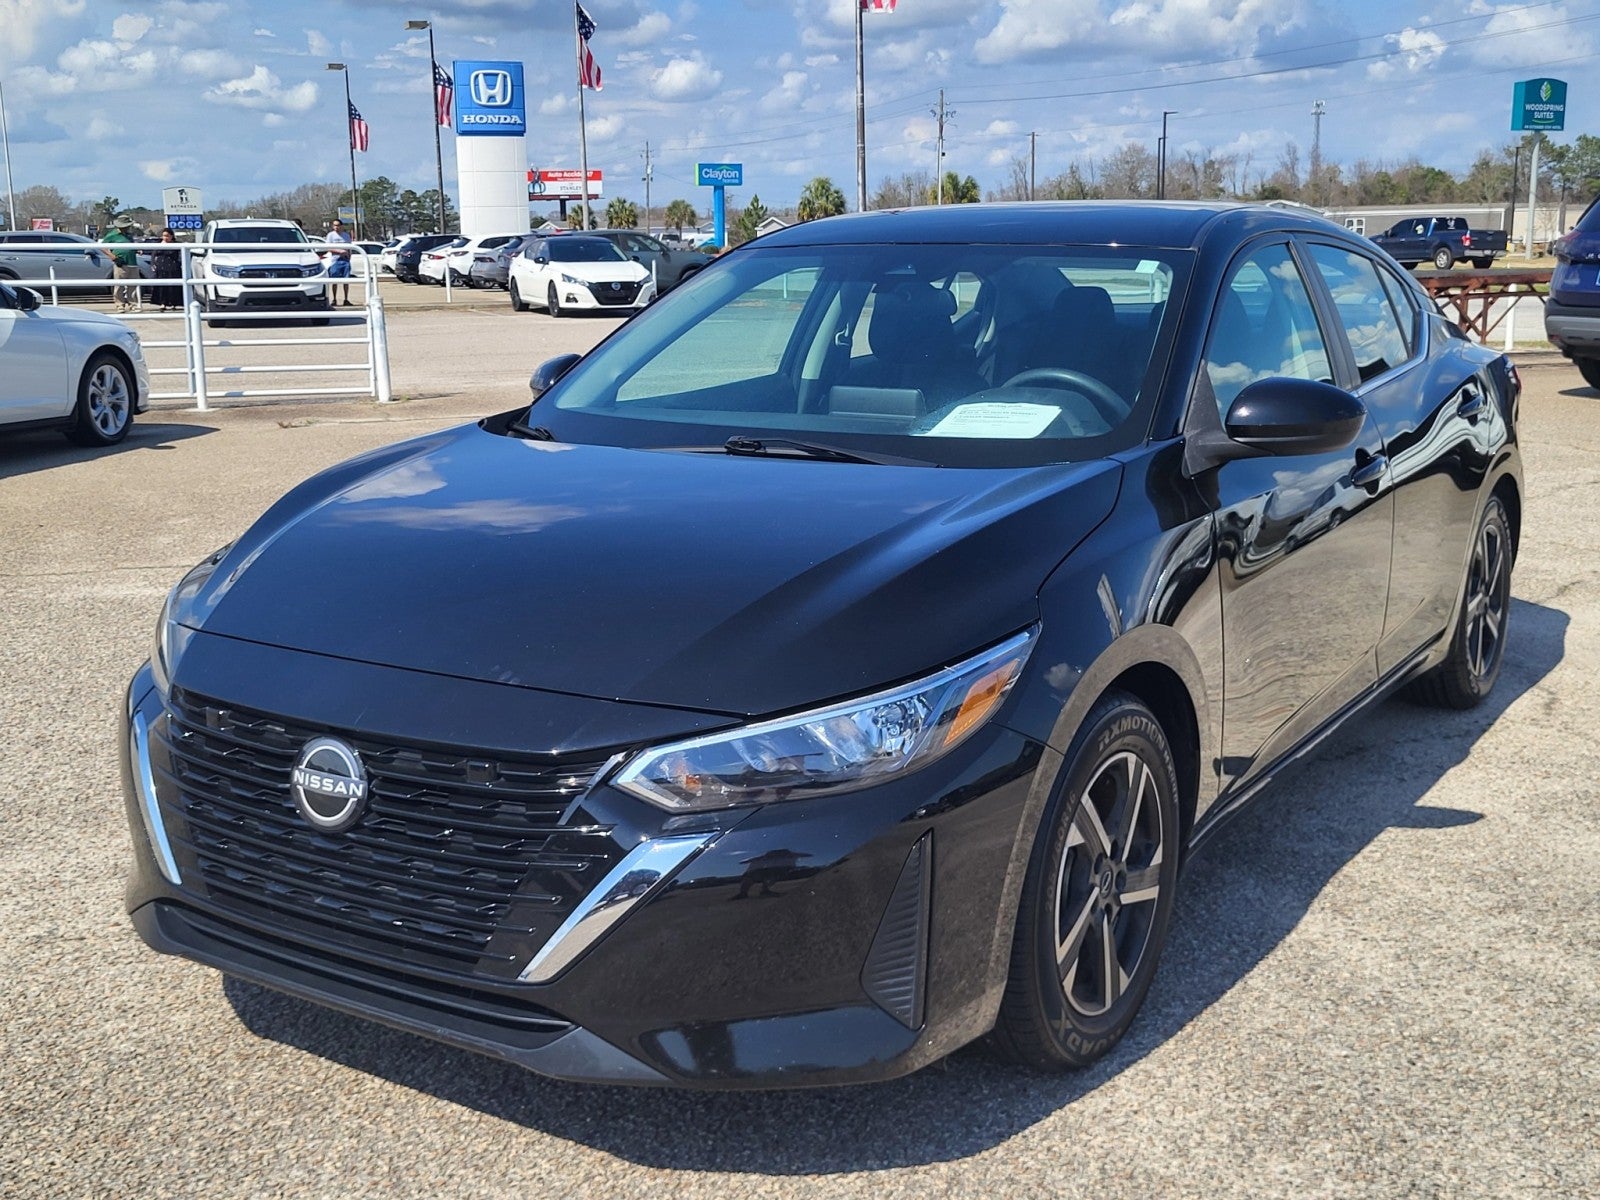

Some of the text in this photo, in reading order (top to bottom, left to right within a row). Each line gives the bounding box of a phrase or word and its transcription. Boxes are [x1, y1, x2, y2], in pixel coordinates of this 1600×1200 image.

[462, 114, 523, 124] HONDA
[702, 168, 739, 180] Clayton
[293, 769, 364, 796] NISSAN
